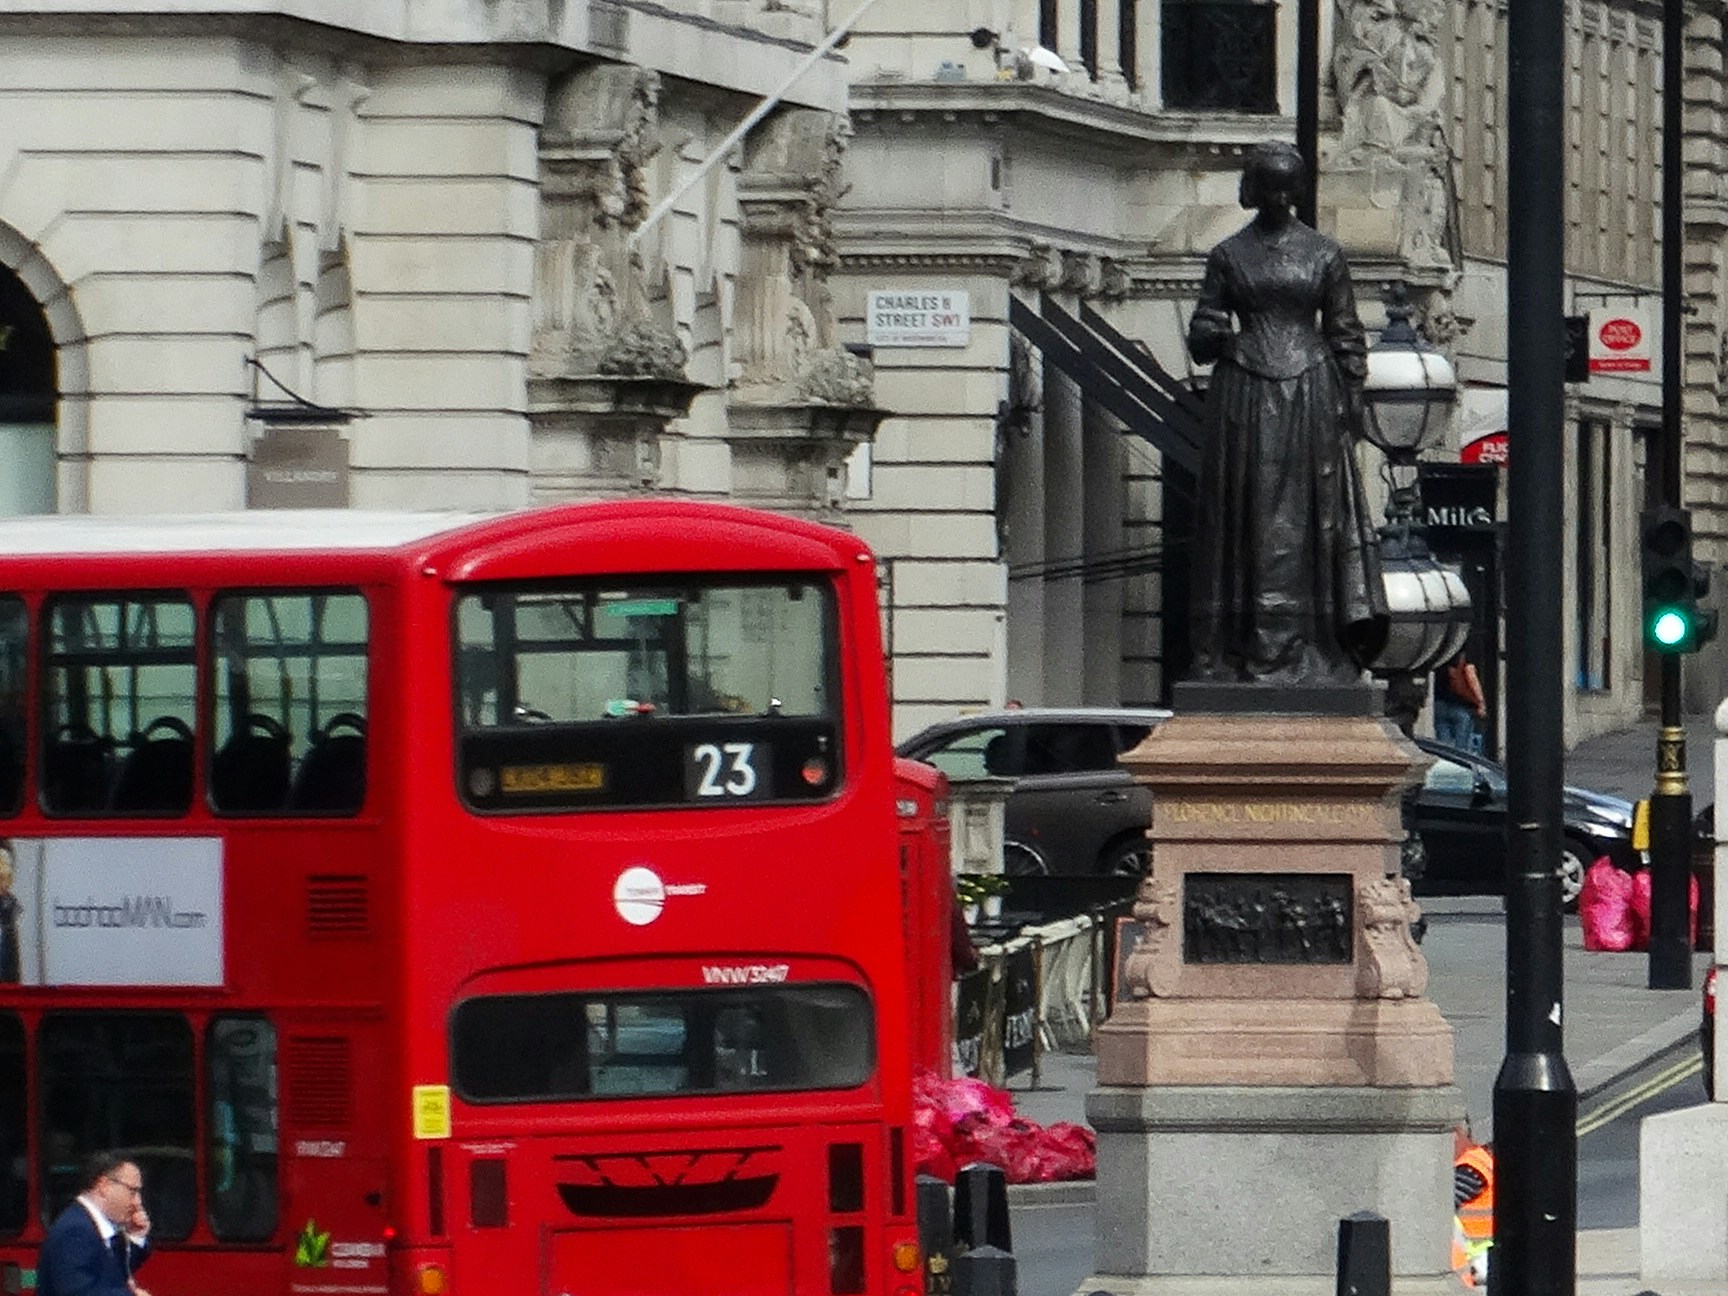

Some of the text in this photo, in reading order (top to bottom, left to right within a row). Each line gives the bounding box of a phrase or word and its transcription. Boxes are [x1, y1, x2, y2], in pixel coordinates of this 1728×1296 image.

[876, 296, 939, 310] CHARLES
[875, 313, 926, 327] STREET
[695, 743, 758, 796] 23
